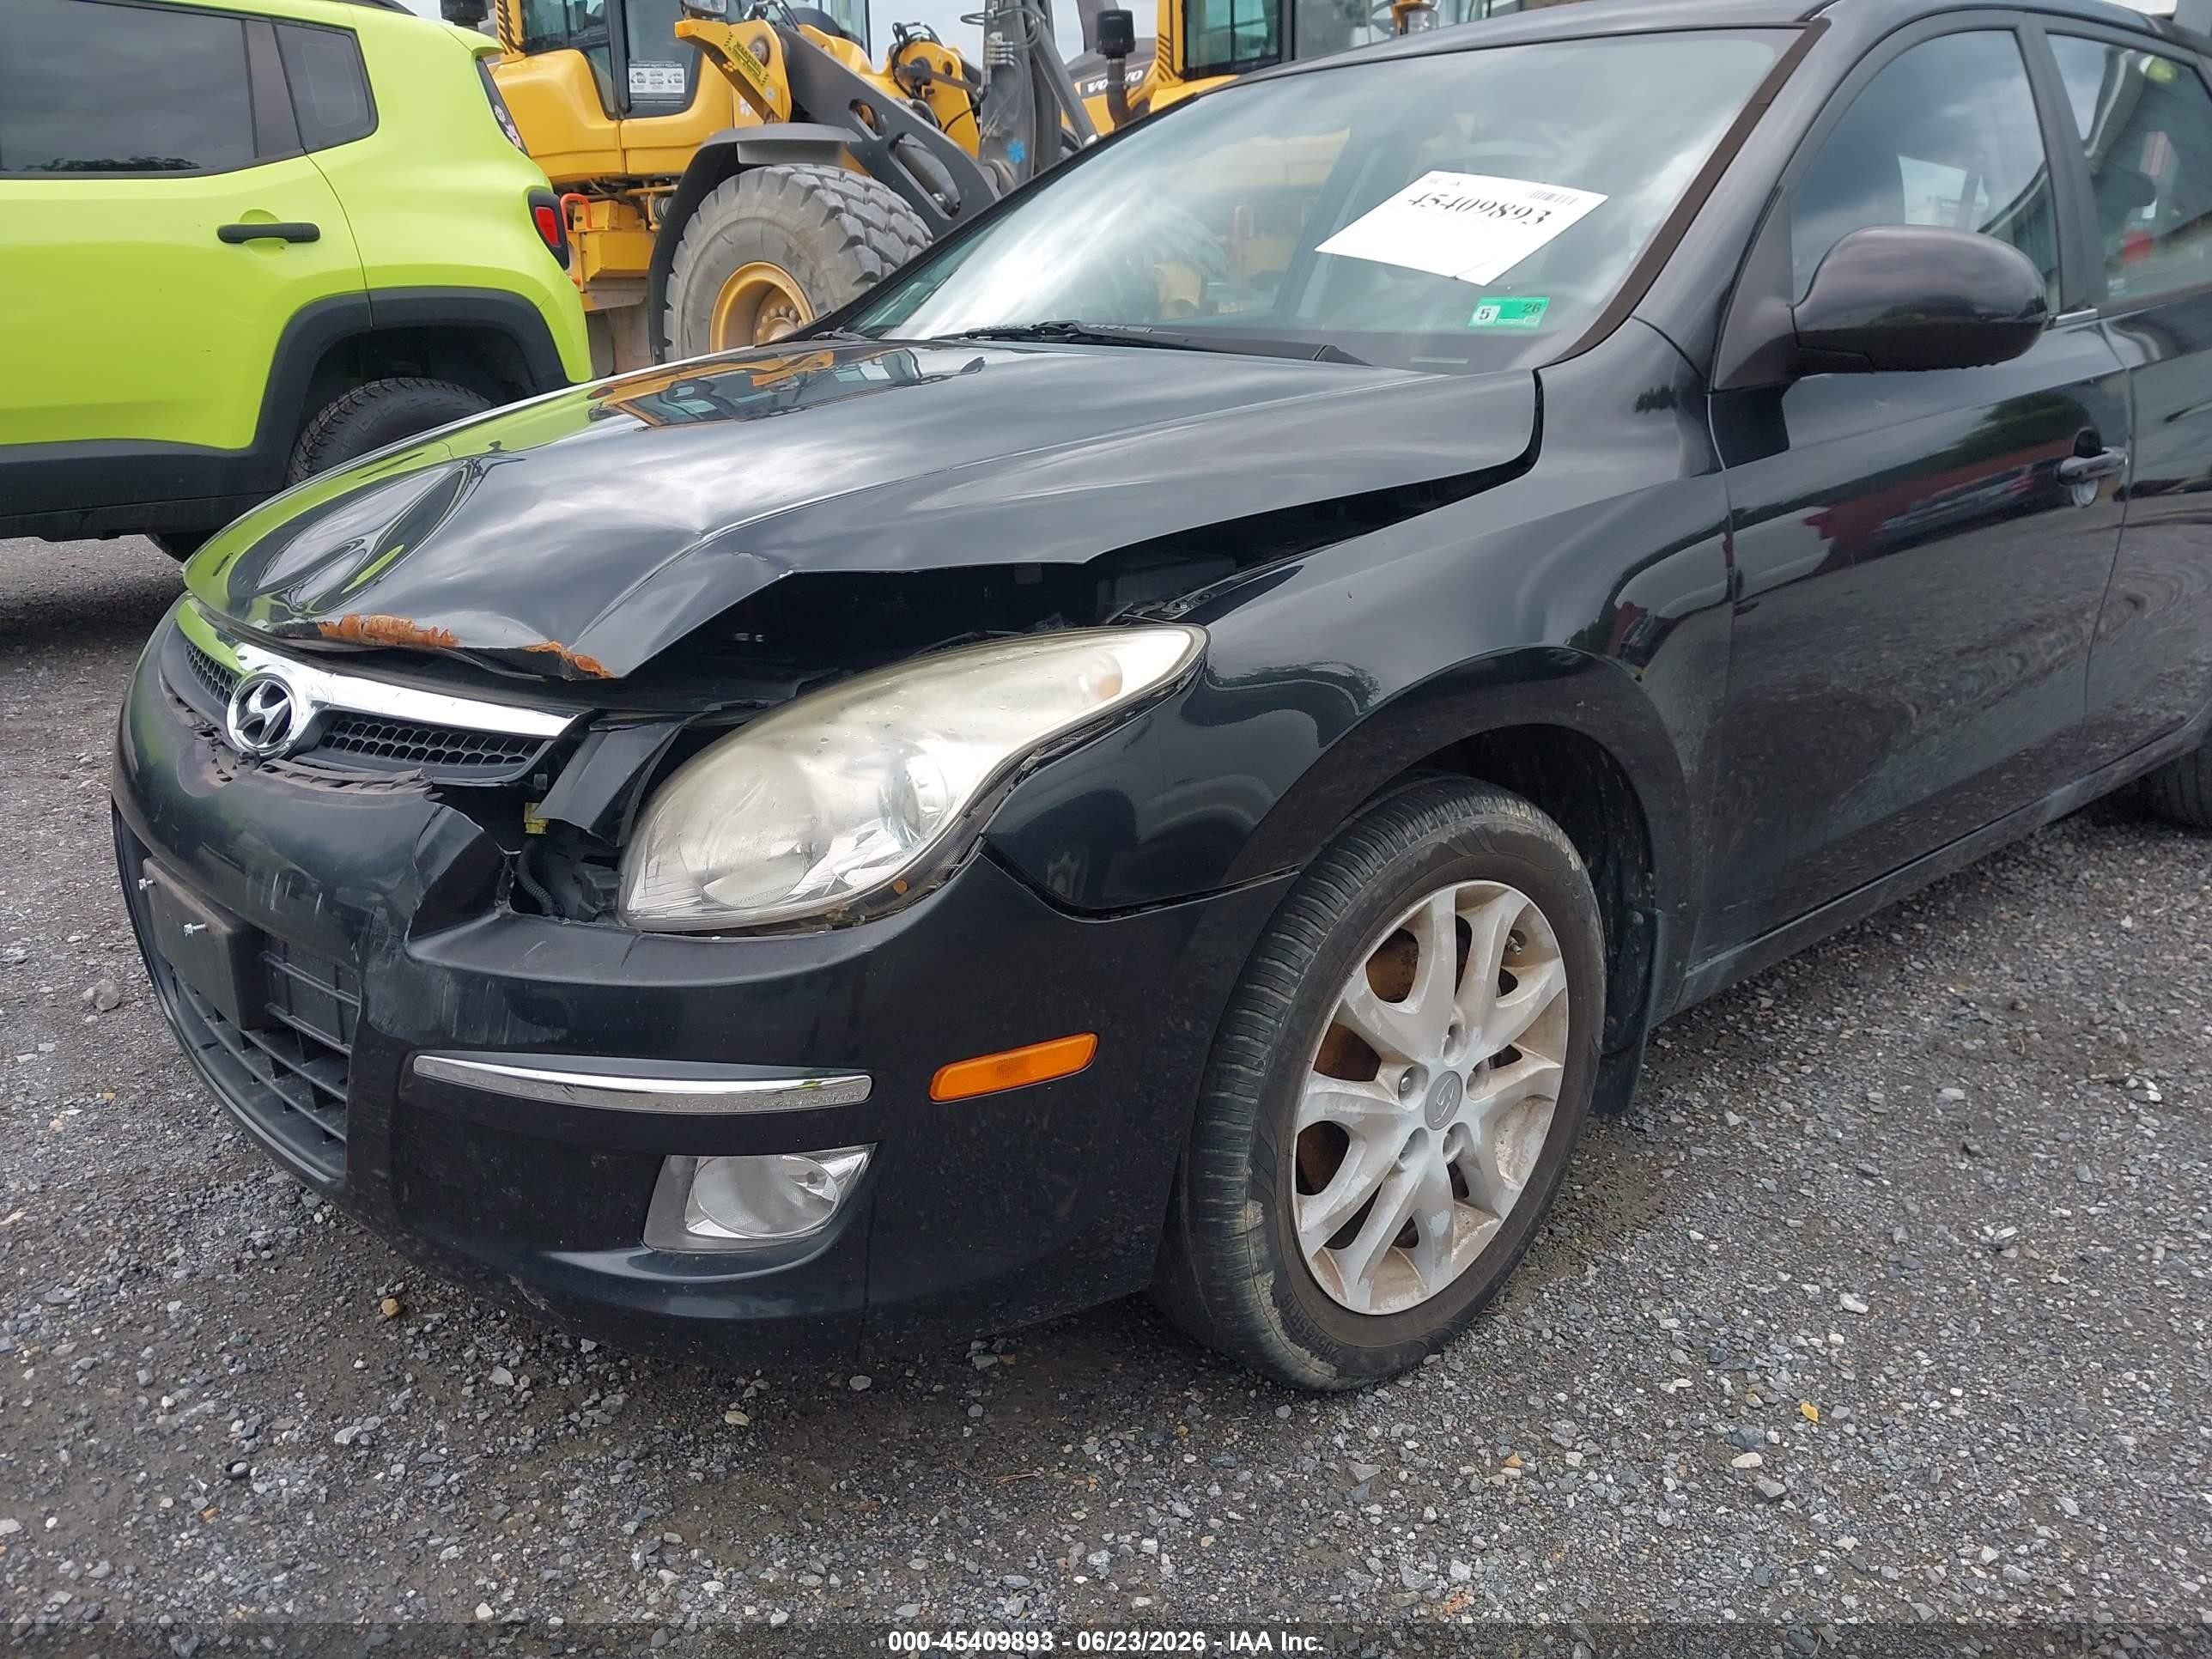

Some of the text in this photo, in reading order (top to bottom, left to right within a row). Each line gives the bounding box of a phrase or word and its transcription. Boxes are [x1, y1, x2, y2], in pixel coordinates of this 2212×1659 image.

[1407, 191, 1552, 225] 45409893
[1479, 307, 1492, 320] 5
[1522, 303, 1542, 313] 26
